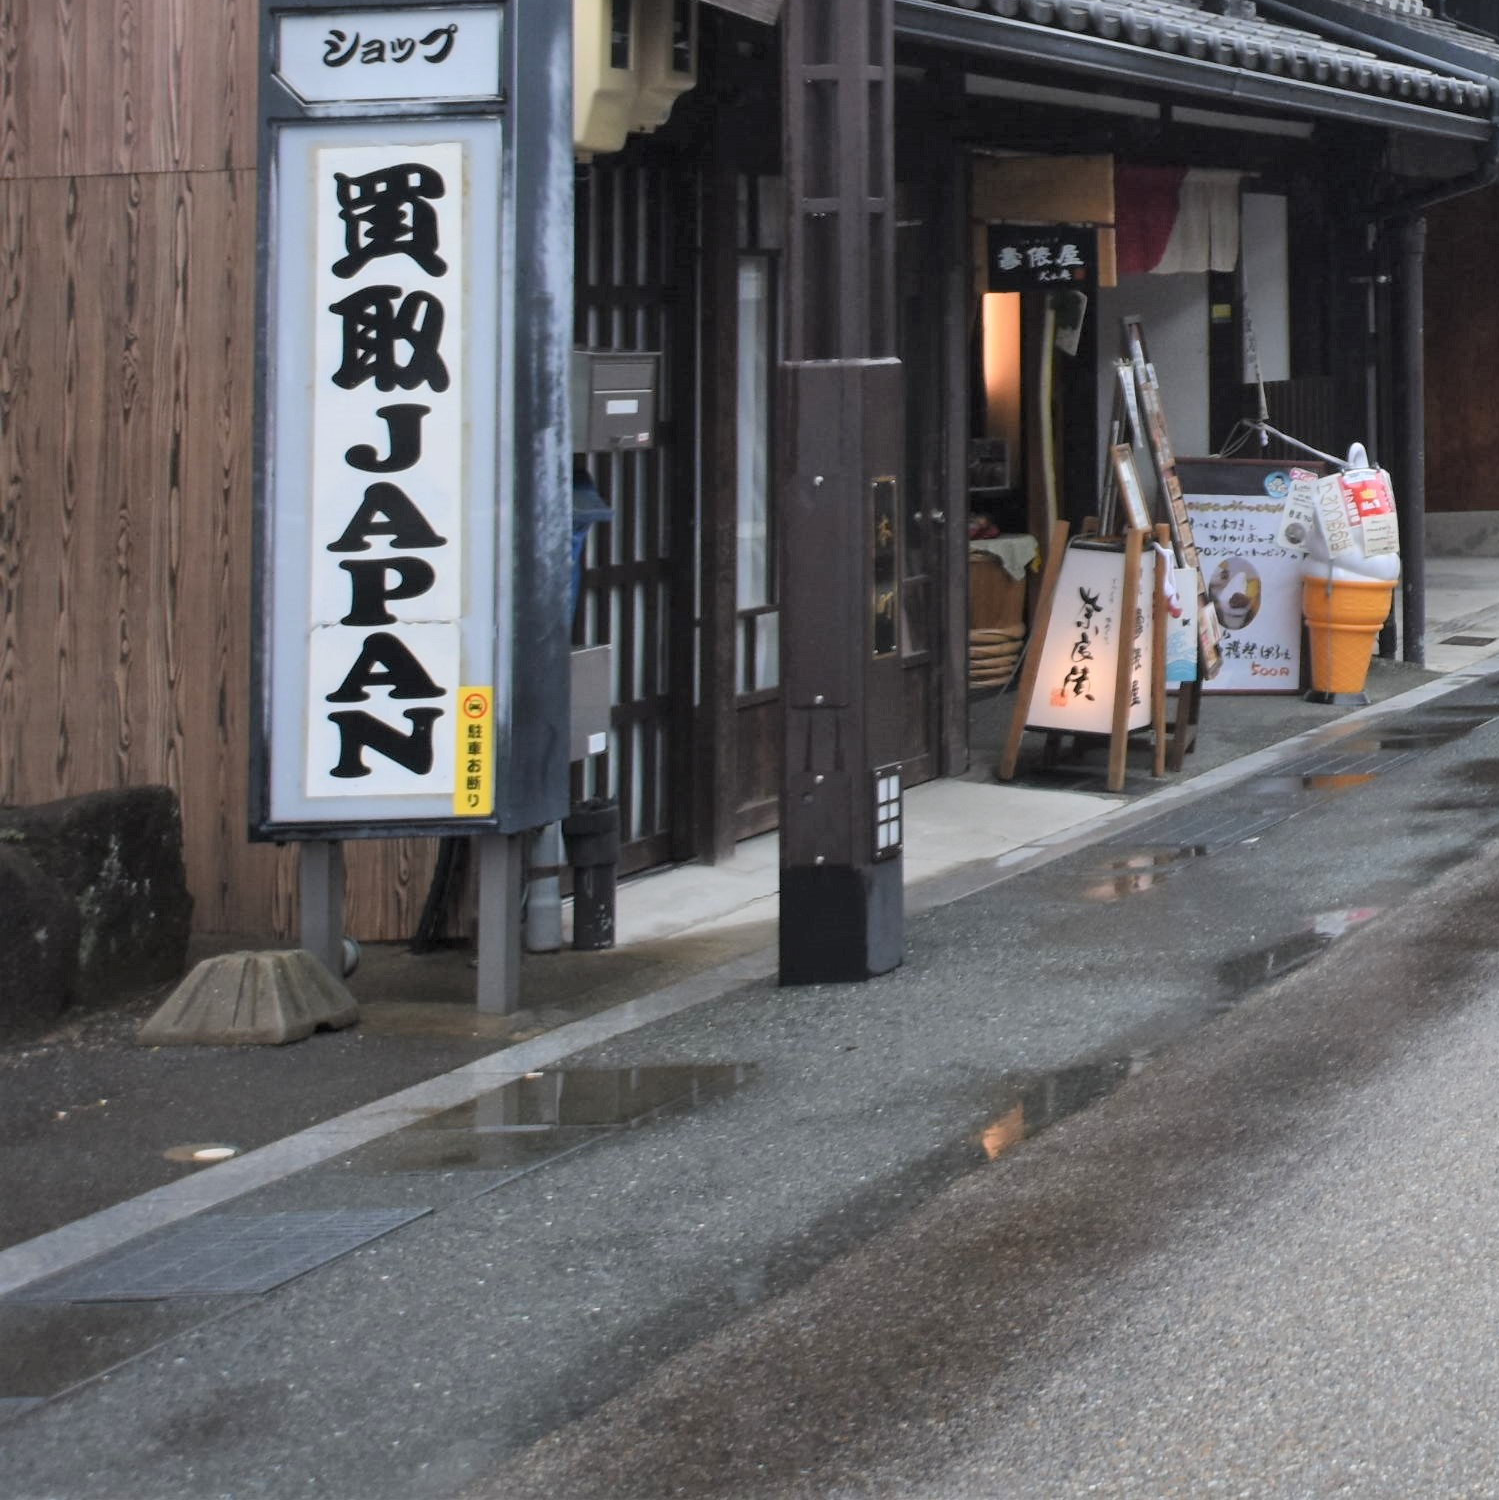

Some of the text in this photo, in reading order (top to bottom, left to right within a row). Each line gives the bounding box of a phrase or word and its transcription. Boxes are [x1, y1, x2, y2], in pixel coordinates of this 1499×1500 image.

[323, 22, 458, 68] ショップ
[327, 162, 449, 779] 買取JAPAN
[466, 723, 483, 808] 駐車お断り
